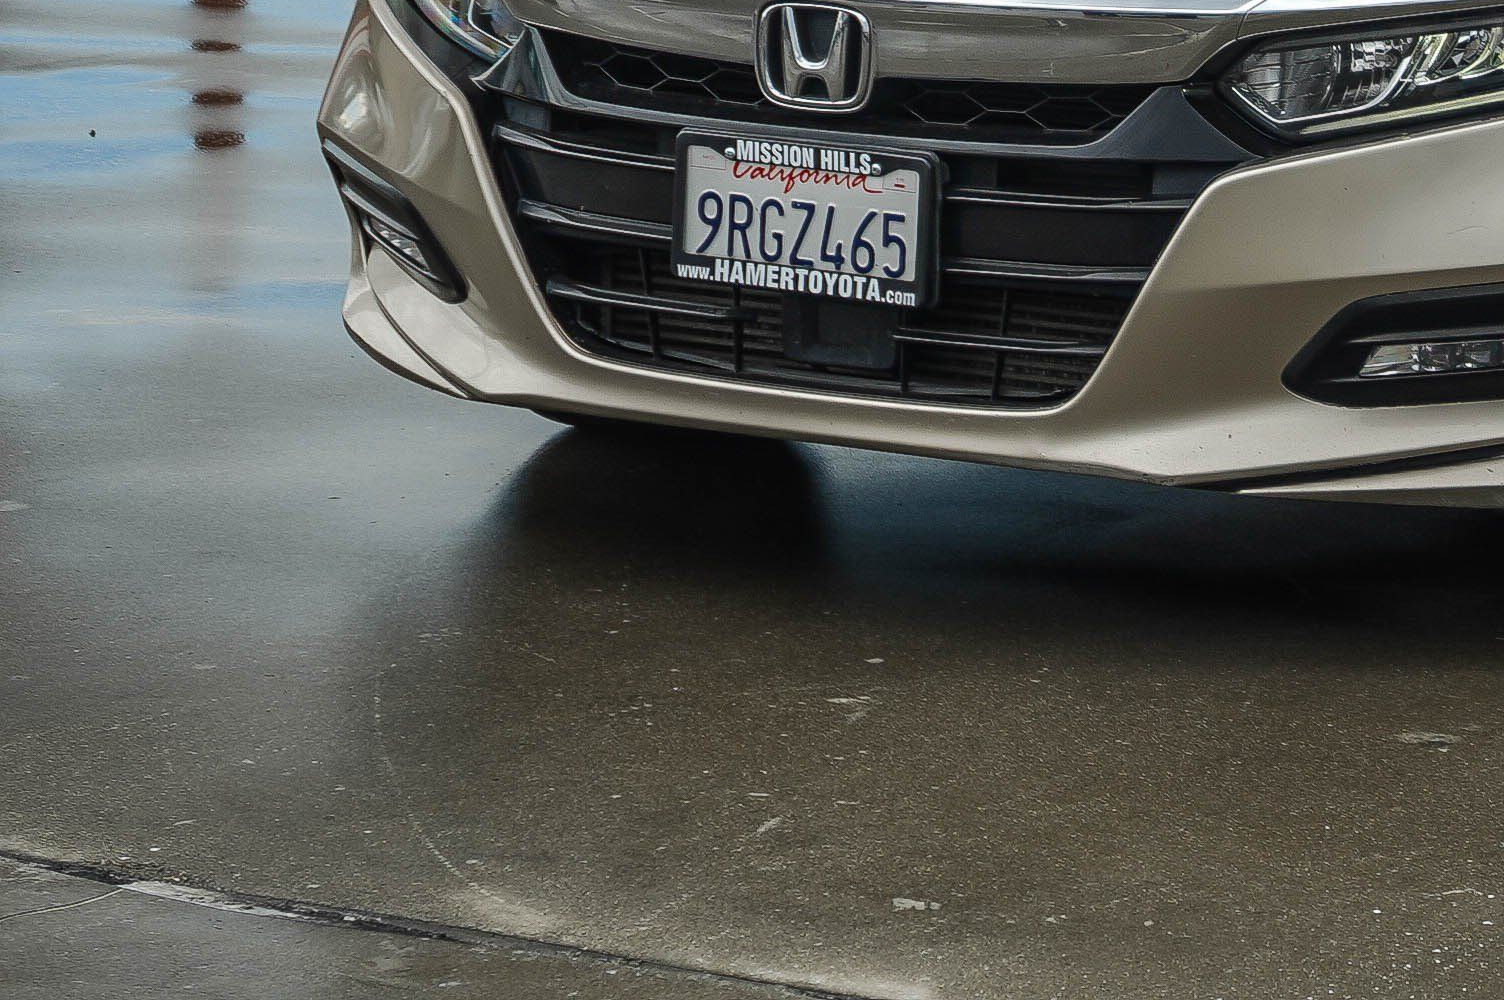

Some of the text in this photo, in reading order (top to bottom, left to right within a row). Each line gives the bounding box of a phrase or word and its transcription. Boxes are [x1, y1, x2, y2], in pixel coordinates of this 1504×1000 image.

[732, 161, 883, 194] California
[736, 139, 871, 175] MISSION HILLS
[696, 189, 907, 278] 9RGZ465
[676, 258, 916, 307] www.HAMERTOYOTA.com
